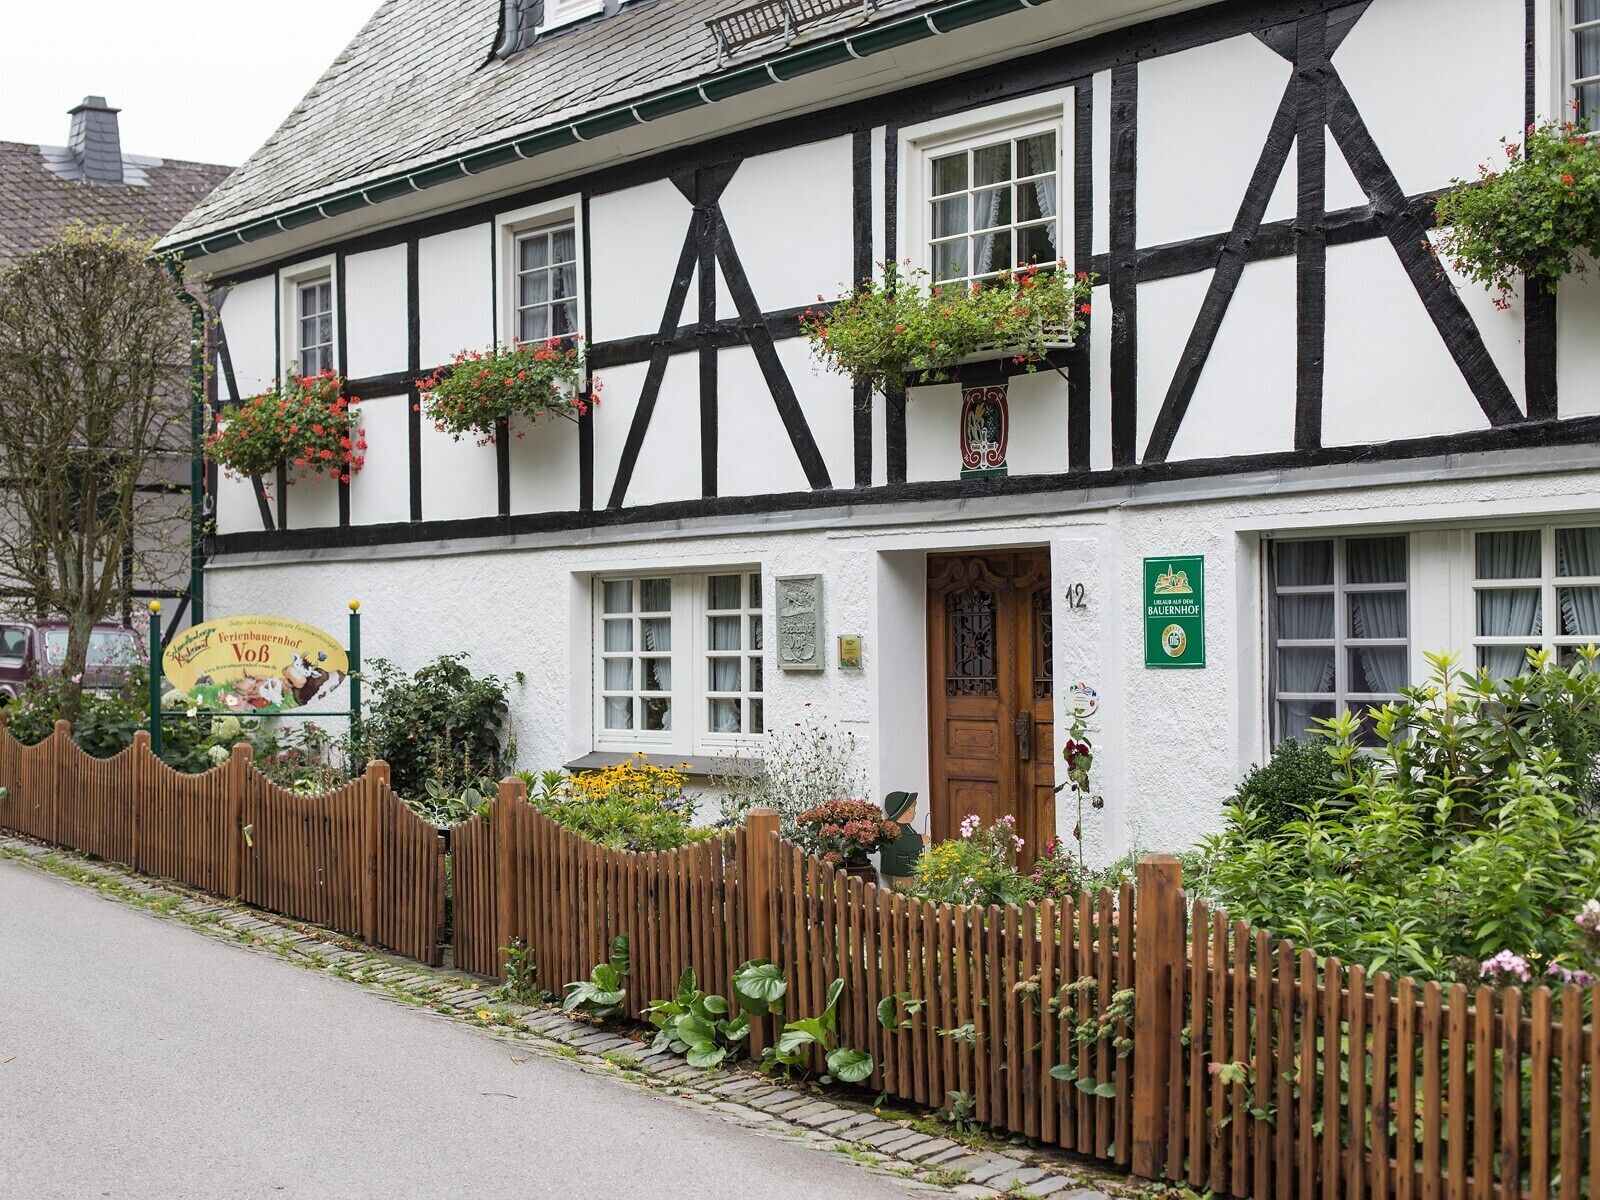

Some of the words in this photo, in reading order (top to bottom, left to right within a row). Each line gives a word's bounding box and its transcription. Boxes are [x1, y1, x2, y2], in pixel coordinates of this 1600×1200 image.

[1065, 582, 1087, 609] 12
[1148, 604, 1199, 615] BAUERNHOF
[218, 631, 302, 648] Ferienbauernhof
[232, 642, 269, 663] Voß
